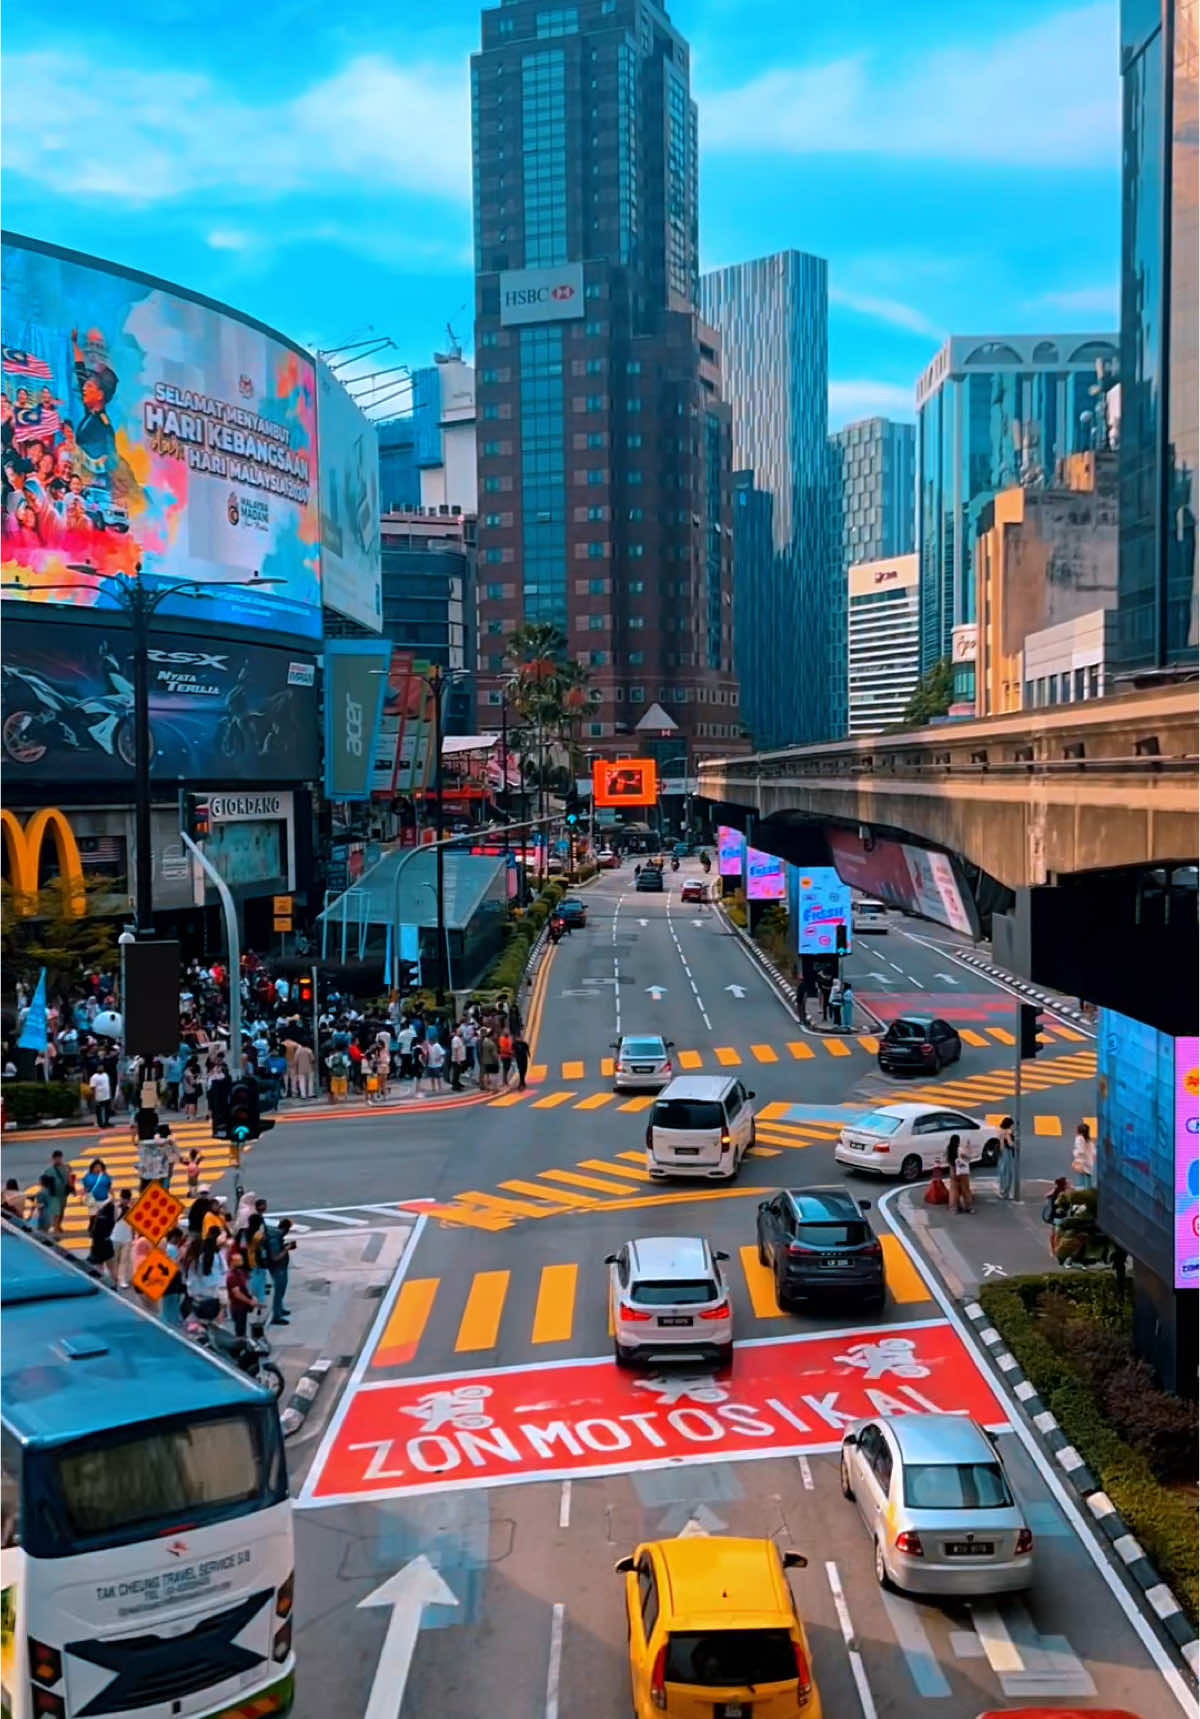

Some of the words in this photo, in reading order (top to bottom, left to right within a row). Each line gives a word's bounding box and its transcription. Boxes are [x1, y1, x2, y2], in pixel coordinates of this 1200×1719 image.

[505, 287, 550, 307] HSBC
[154, 382, 223, 419] SELAMAT
[224, 403, 290, 445] MENYAMBUT
[145, 402, 206, 446] HARI
[206, 418, 309, 483] KEBANGSAAN
[188, 447, 227, 478] HARI
[346, 692, 362, 757] acer
[210, 797, 280, 817] GIORDANO
[348, 1428, 523, 1480] ZON
[519, 1385, 970, 1459] MOTOSIKAL
[118, 1576, 160, 1597] CHEUNG
[161, 1566, 197, 1584] TRAVEL
[198, 1555, 236, 1577] SERVICE
